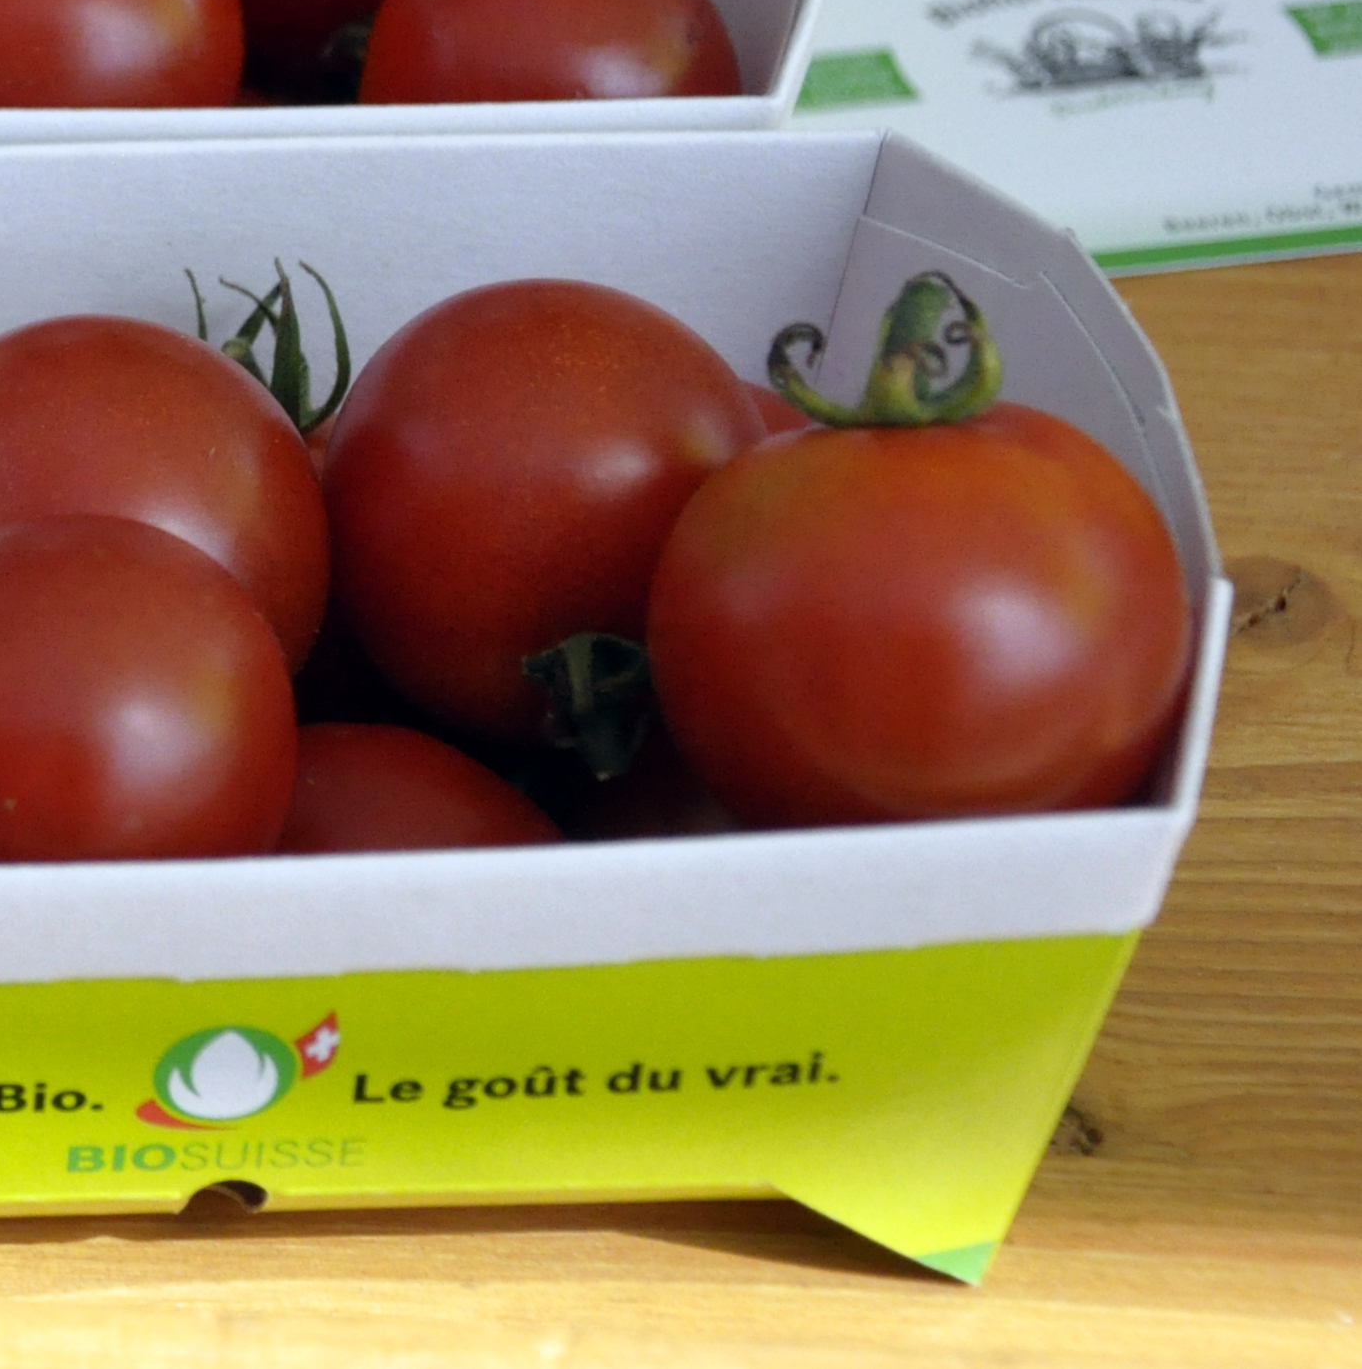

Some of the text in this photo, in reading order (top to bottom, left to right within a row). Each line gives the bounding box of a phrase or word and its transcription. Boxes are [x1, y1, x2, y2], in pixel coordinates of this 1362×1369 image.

[352, 1073, 425, 1105] Le
[442, 1066, 586, 1110] goût
[606, 1061, 683, 1094] du
[705, 1051, 842, 1090] vrai.
